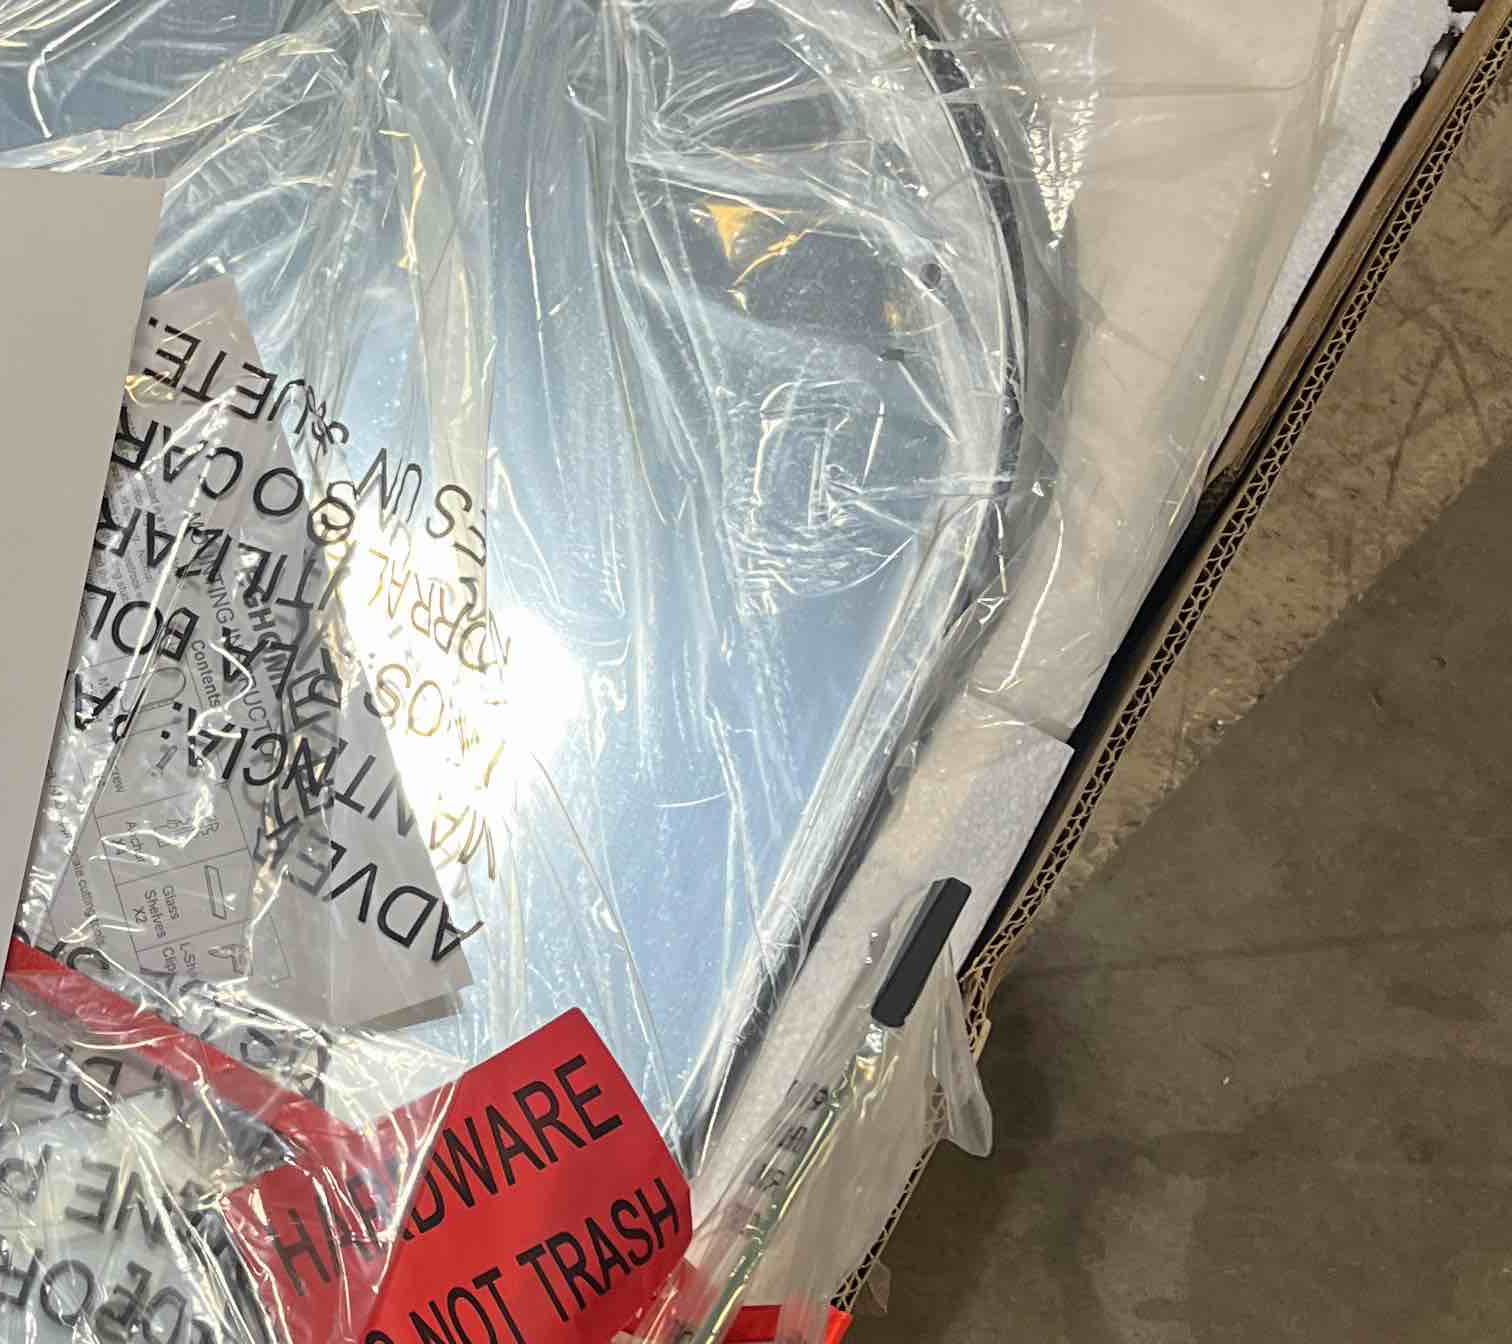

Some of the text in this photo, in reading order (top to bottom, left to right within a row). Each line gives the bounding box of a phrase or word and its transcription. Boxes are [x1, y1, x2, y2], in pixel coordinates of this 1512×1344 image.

[190, 639, 222, 709] Contents
[144, 889, 167, 939] Shelves
[161, 885, 181, 920] Glass
[269, 1054, 624, 1297] HARDWARE
[516, 1177, 680, 1323] TRASH
